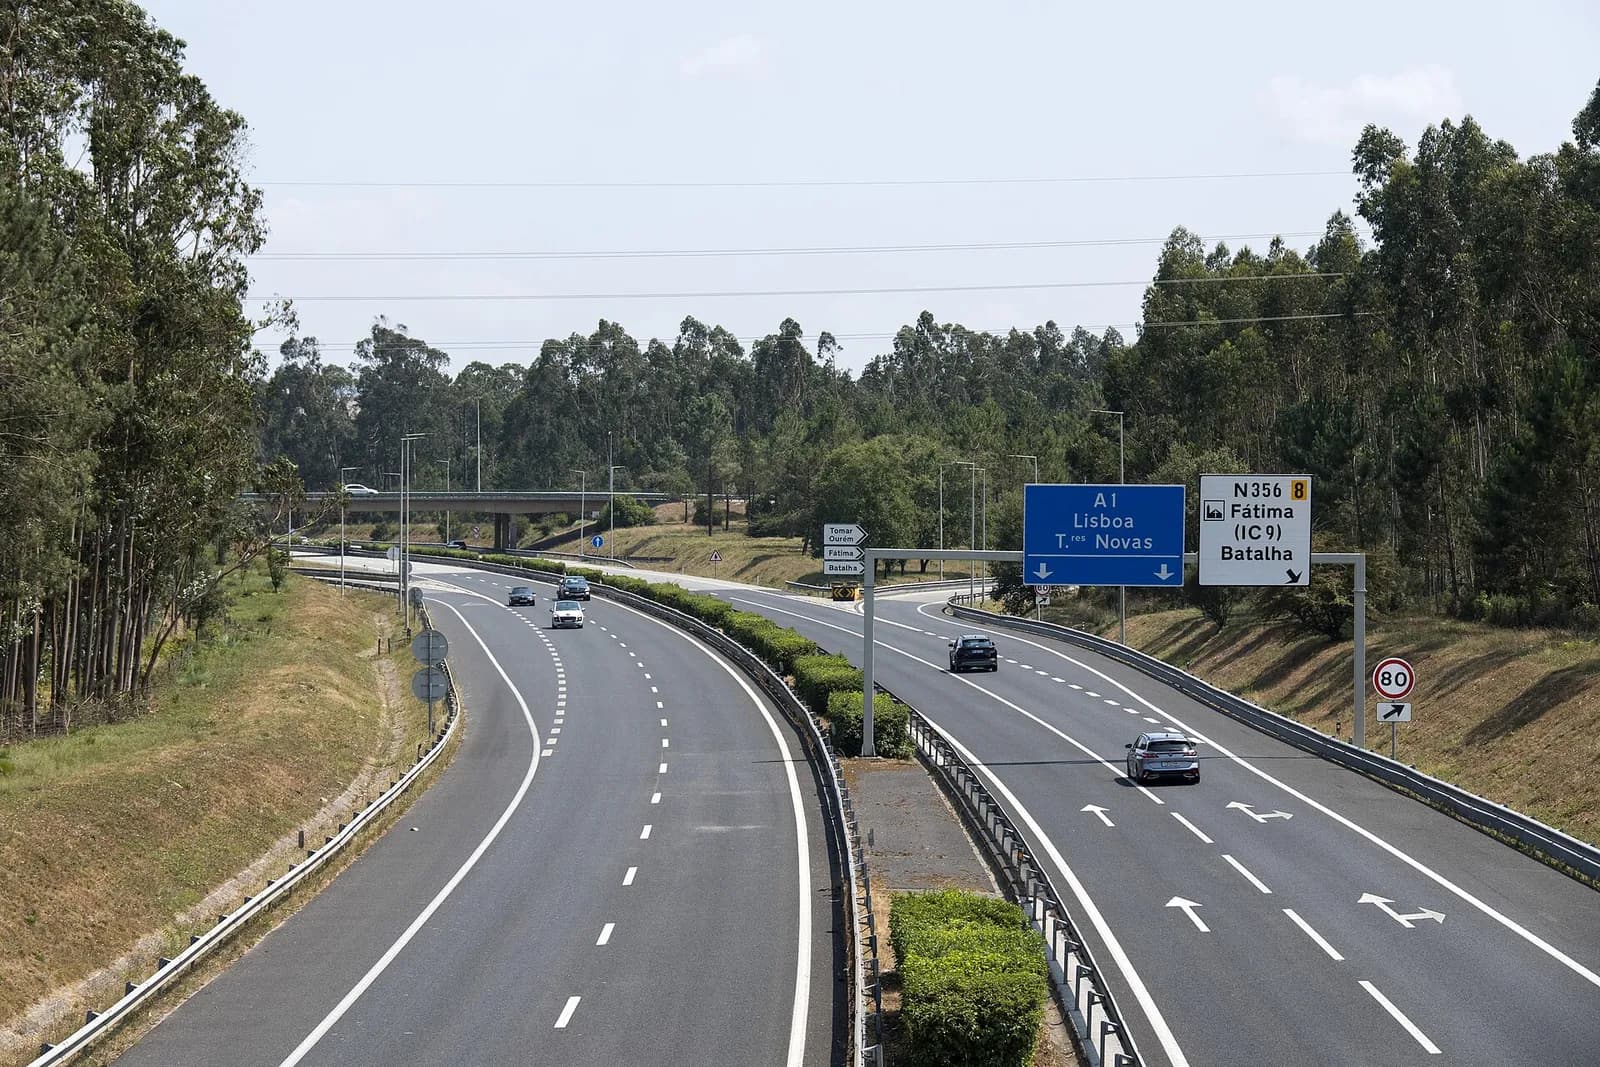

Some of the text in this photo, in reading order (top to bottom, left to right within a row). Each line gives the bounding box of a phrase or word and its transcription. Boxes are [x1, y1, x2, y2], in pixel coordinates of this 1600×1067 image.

[1234, 482, 1282, 498] N356
[1294, 482, 1304, 499] 8
[1093, 492, 1117, 508] A1
[1231, 503, 1294, 519] Fátima
[1074, 513, 1134, 528] Lisboa
[1095, 533, 1153, 549] Novas
[829, 549, 853, 557] Fátima
[1221, 546, 1293, 561] Batalha
[1381, 671, 1407, 687] 80
